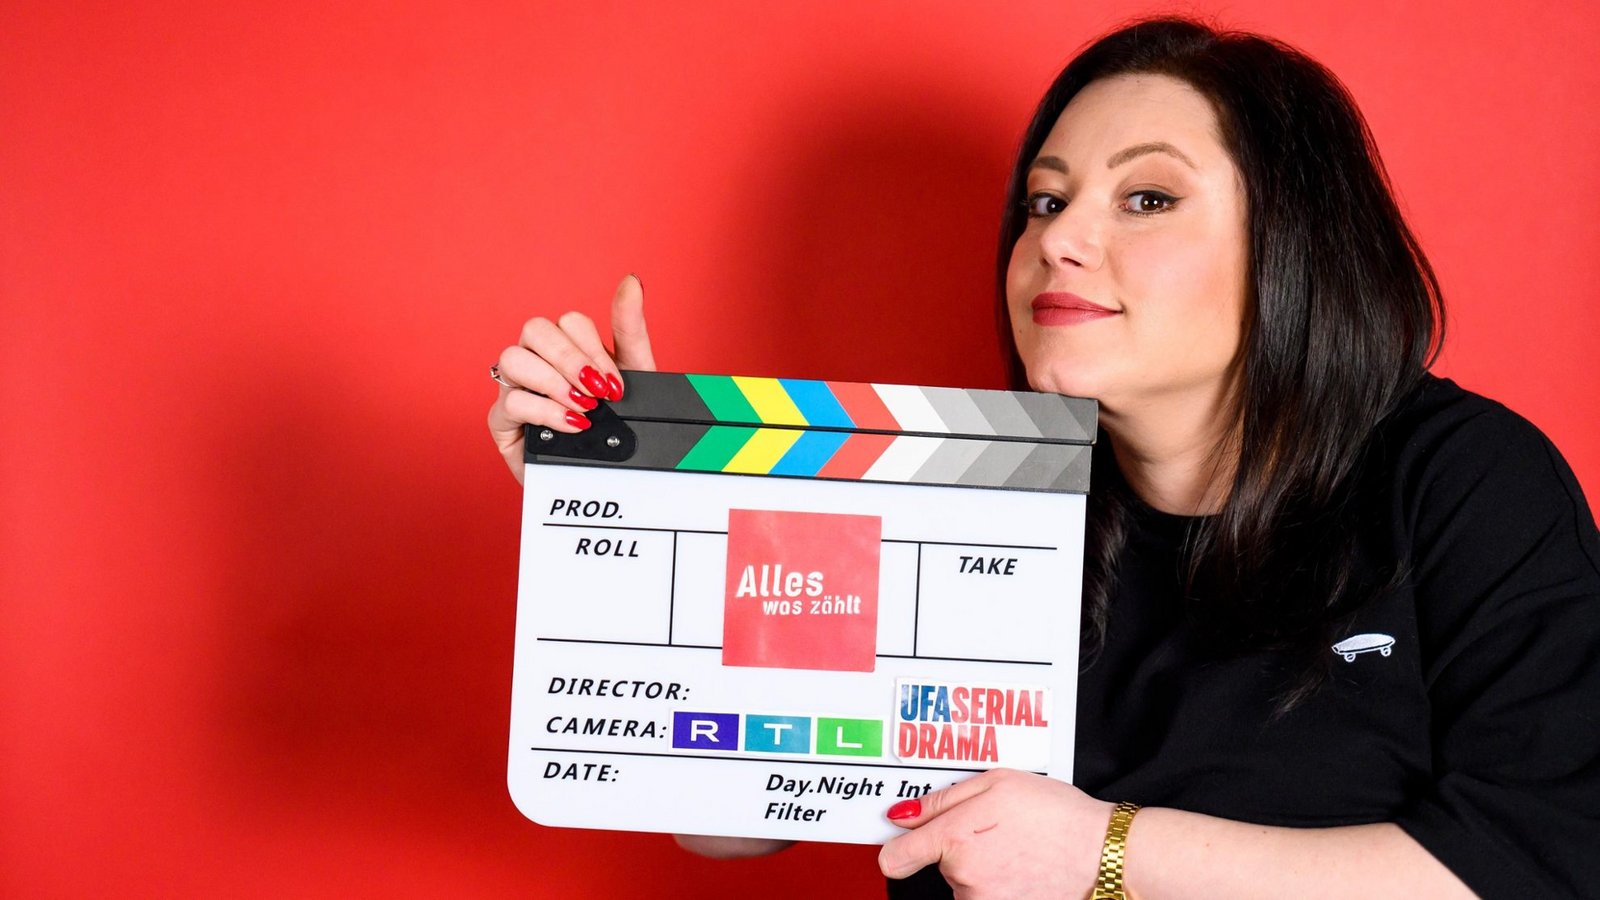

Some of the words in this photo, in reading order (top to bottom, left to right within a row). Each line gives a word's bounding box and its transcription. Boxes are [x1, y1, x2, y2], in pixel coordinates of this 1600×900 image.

[549, 499, 624, 519] PROD.
[575, 538, 640, 557] ROLL
[958, 556, 1018, 575] TAKE
[736, 564, 824, 597] Alles
[763, 600, 803, 616] was
[810, 595, 862, 615] zählt
[548, 677, 690, 700] DIRECTOR:
[546, 716, 667, 738] CAMERA:
[898, 722, 999, 762] DRAMA
[543, 762, 620, 782] DATE:
[765, 774, 884, 800] Day.Night
[764, 802, 827, 822] Filter
